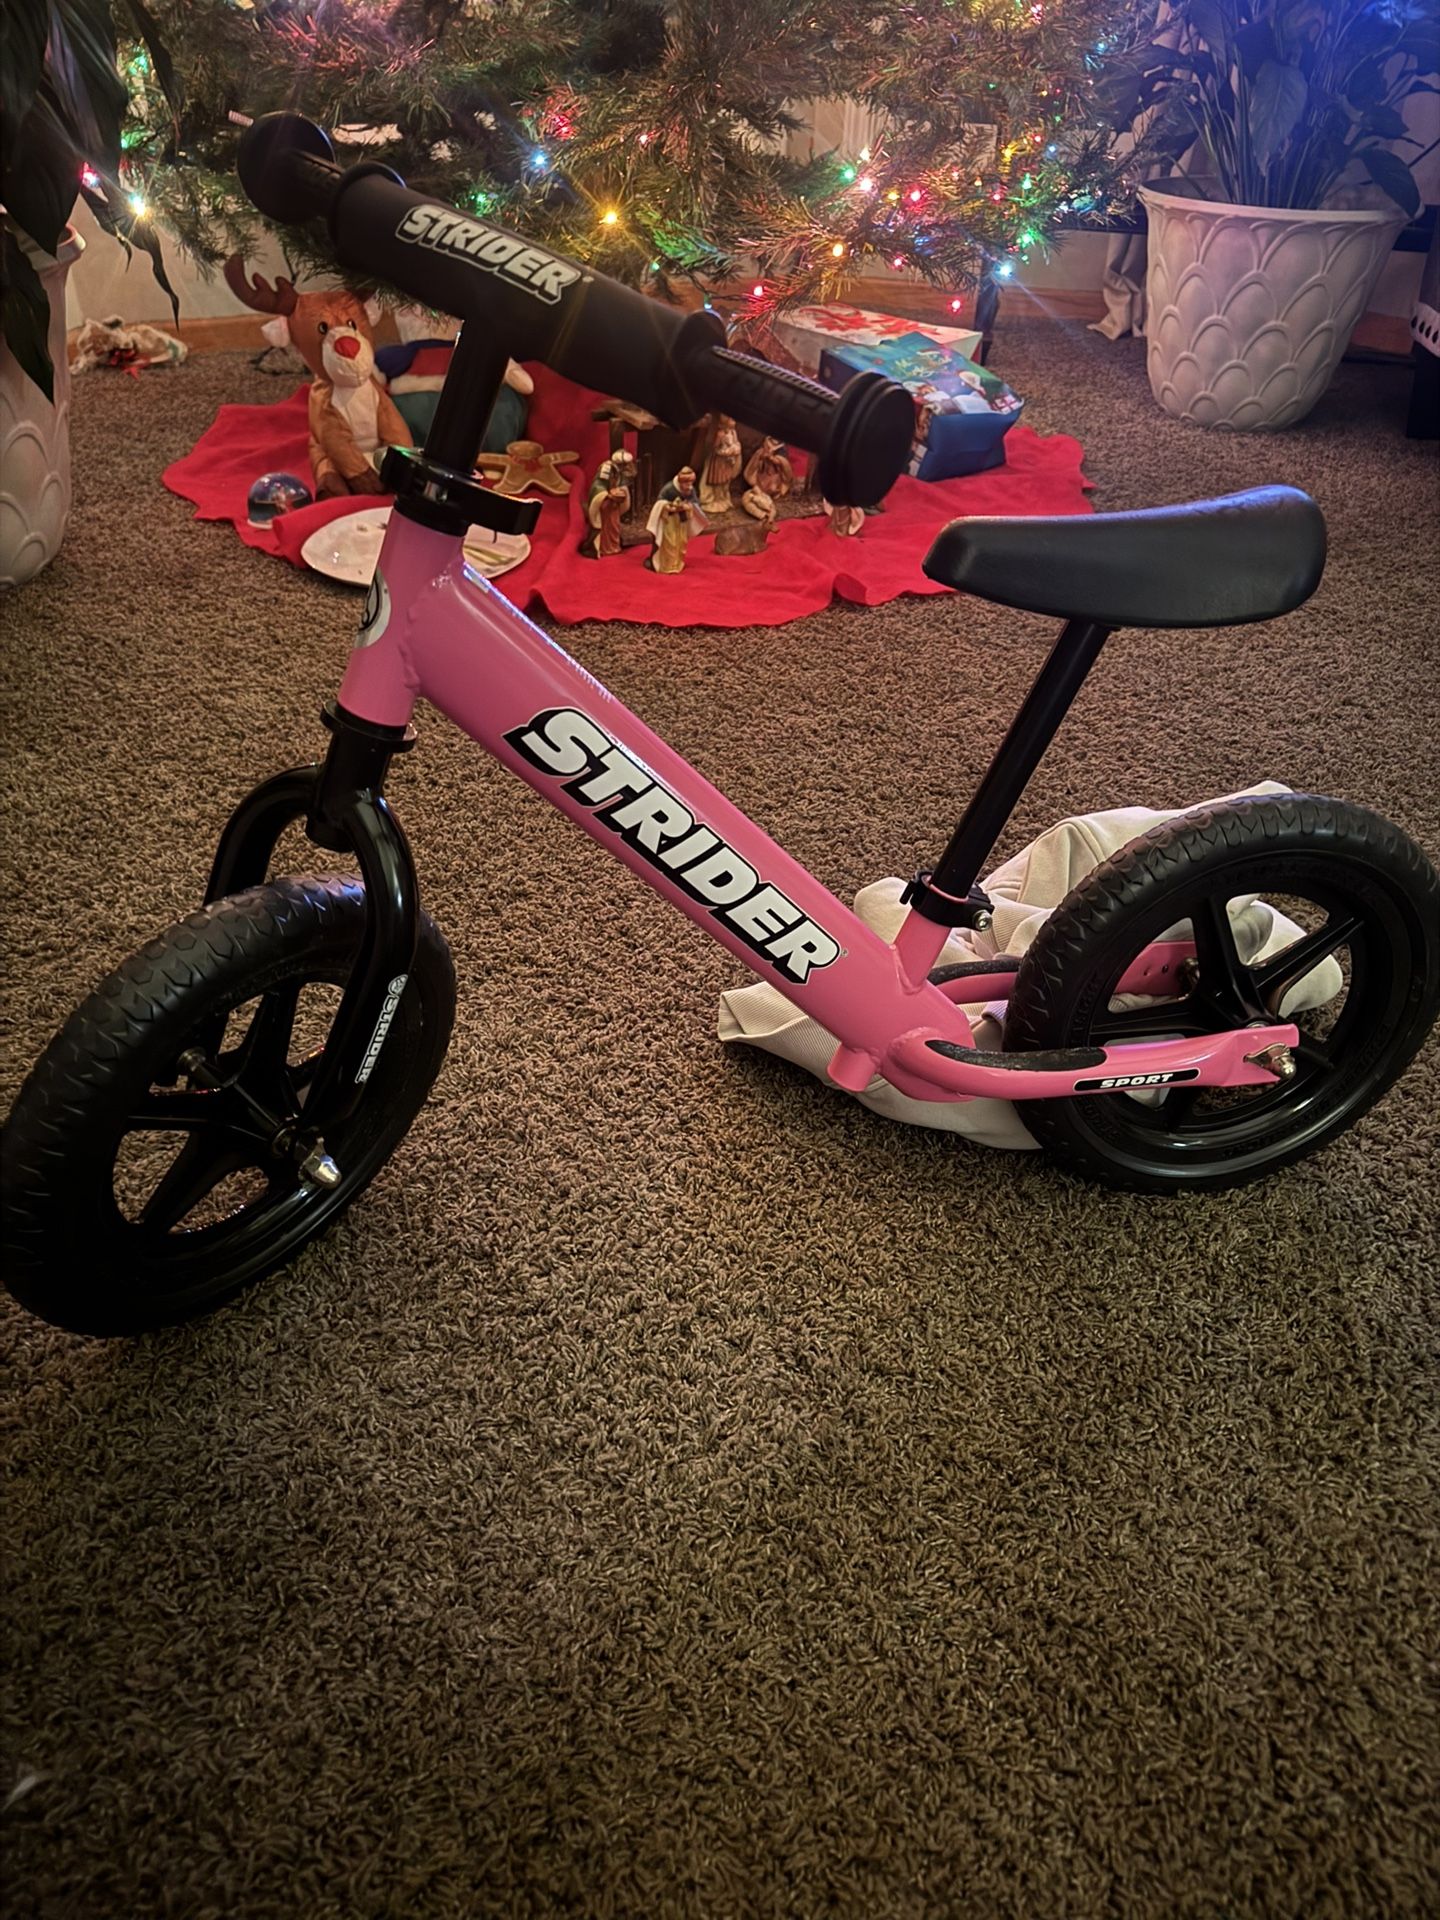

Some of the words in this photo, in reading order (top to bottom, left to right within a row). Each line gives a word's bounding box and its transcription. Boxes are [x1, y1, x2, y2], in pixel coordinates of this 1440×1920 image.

[401, 204, 580, 300] STRIDER
[513, 709, 840, 982] STRIDER
[357, 995, 399, 1082] STRIDER
[1100, 1073, 1174, 1089] SPORT
